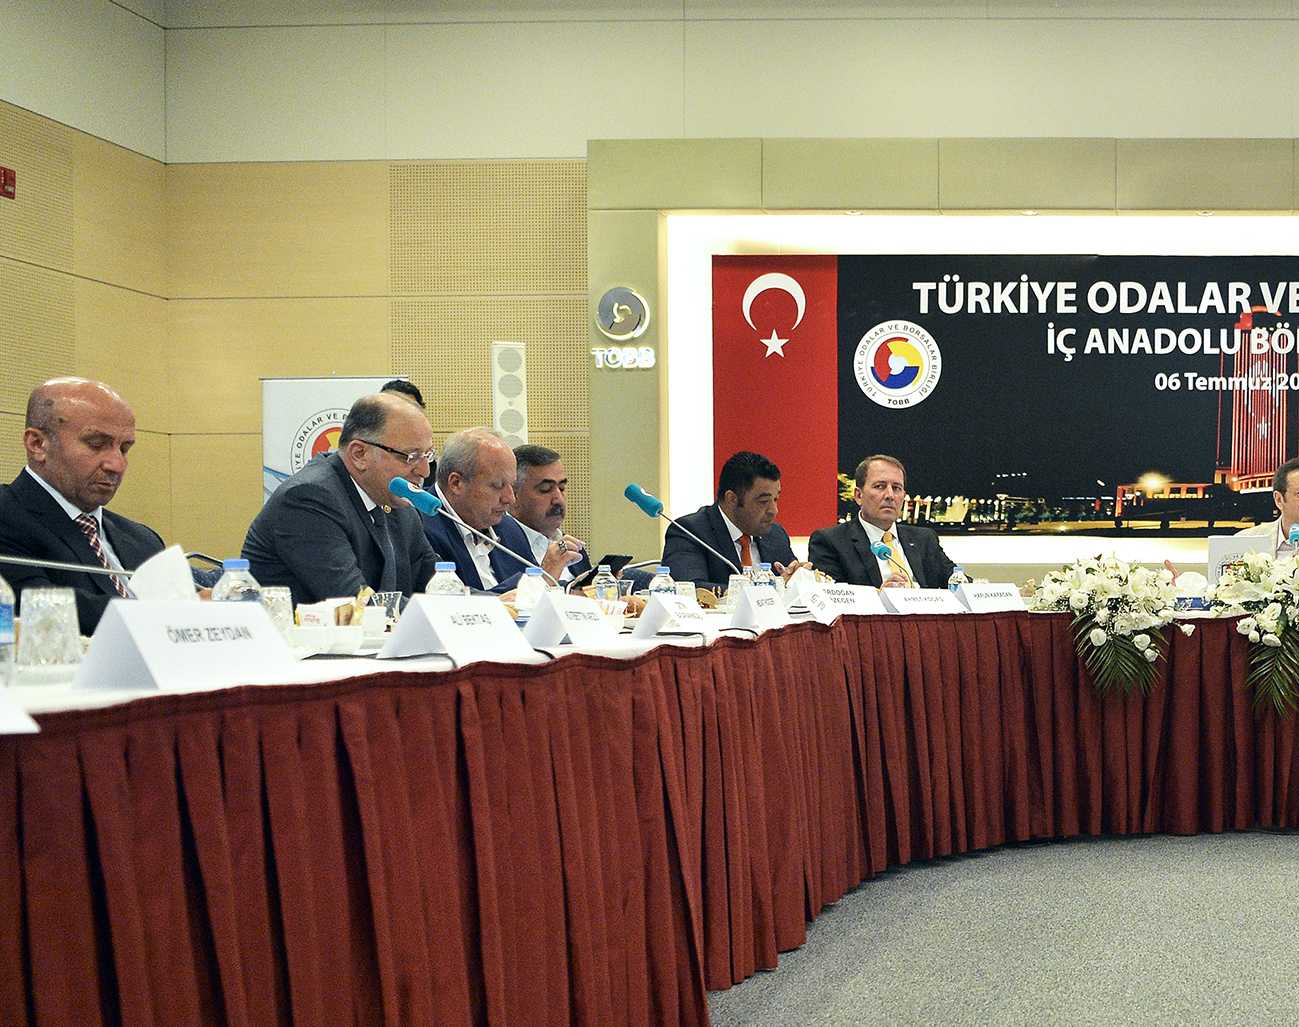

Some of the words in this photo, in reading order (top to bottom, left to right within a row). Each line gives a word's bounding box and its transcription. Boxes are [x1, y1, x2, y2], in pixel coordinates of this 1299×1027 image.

[912, 274, 1078, 314] TÜRKİYE
[1087, 281, 1252, 314] ODALAR
[1047, 322, 1077, 362] İÇ
[1084, 327, 1242, 355] ANADOLU
[592, 347, 656, 369] TOBB
[1154, 372, 1182, 391] 06
[1184, 371, 1272, 391] Temmuz
[887, 398, 910, 406] TOBB
